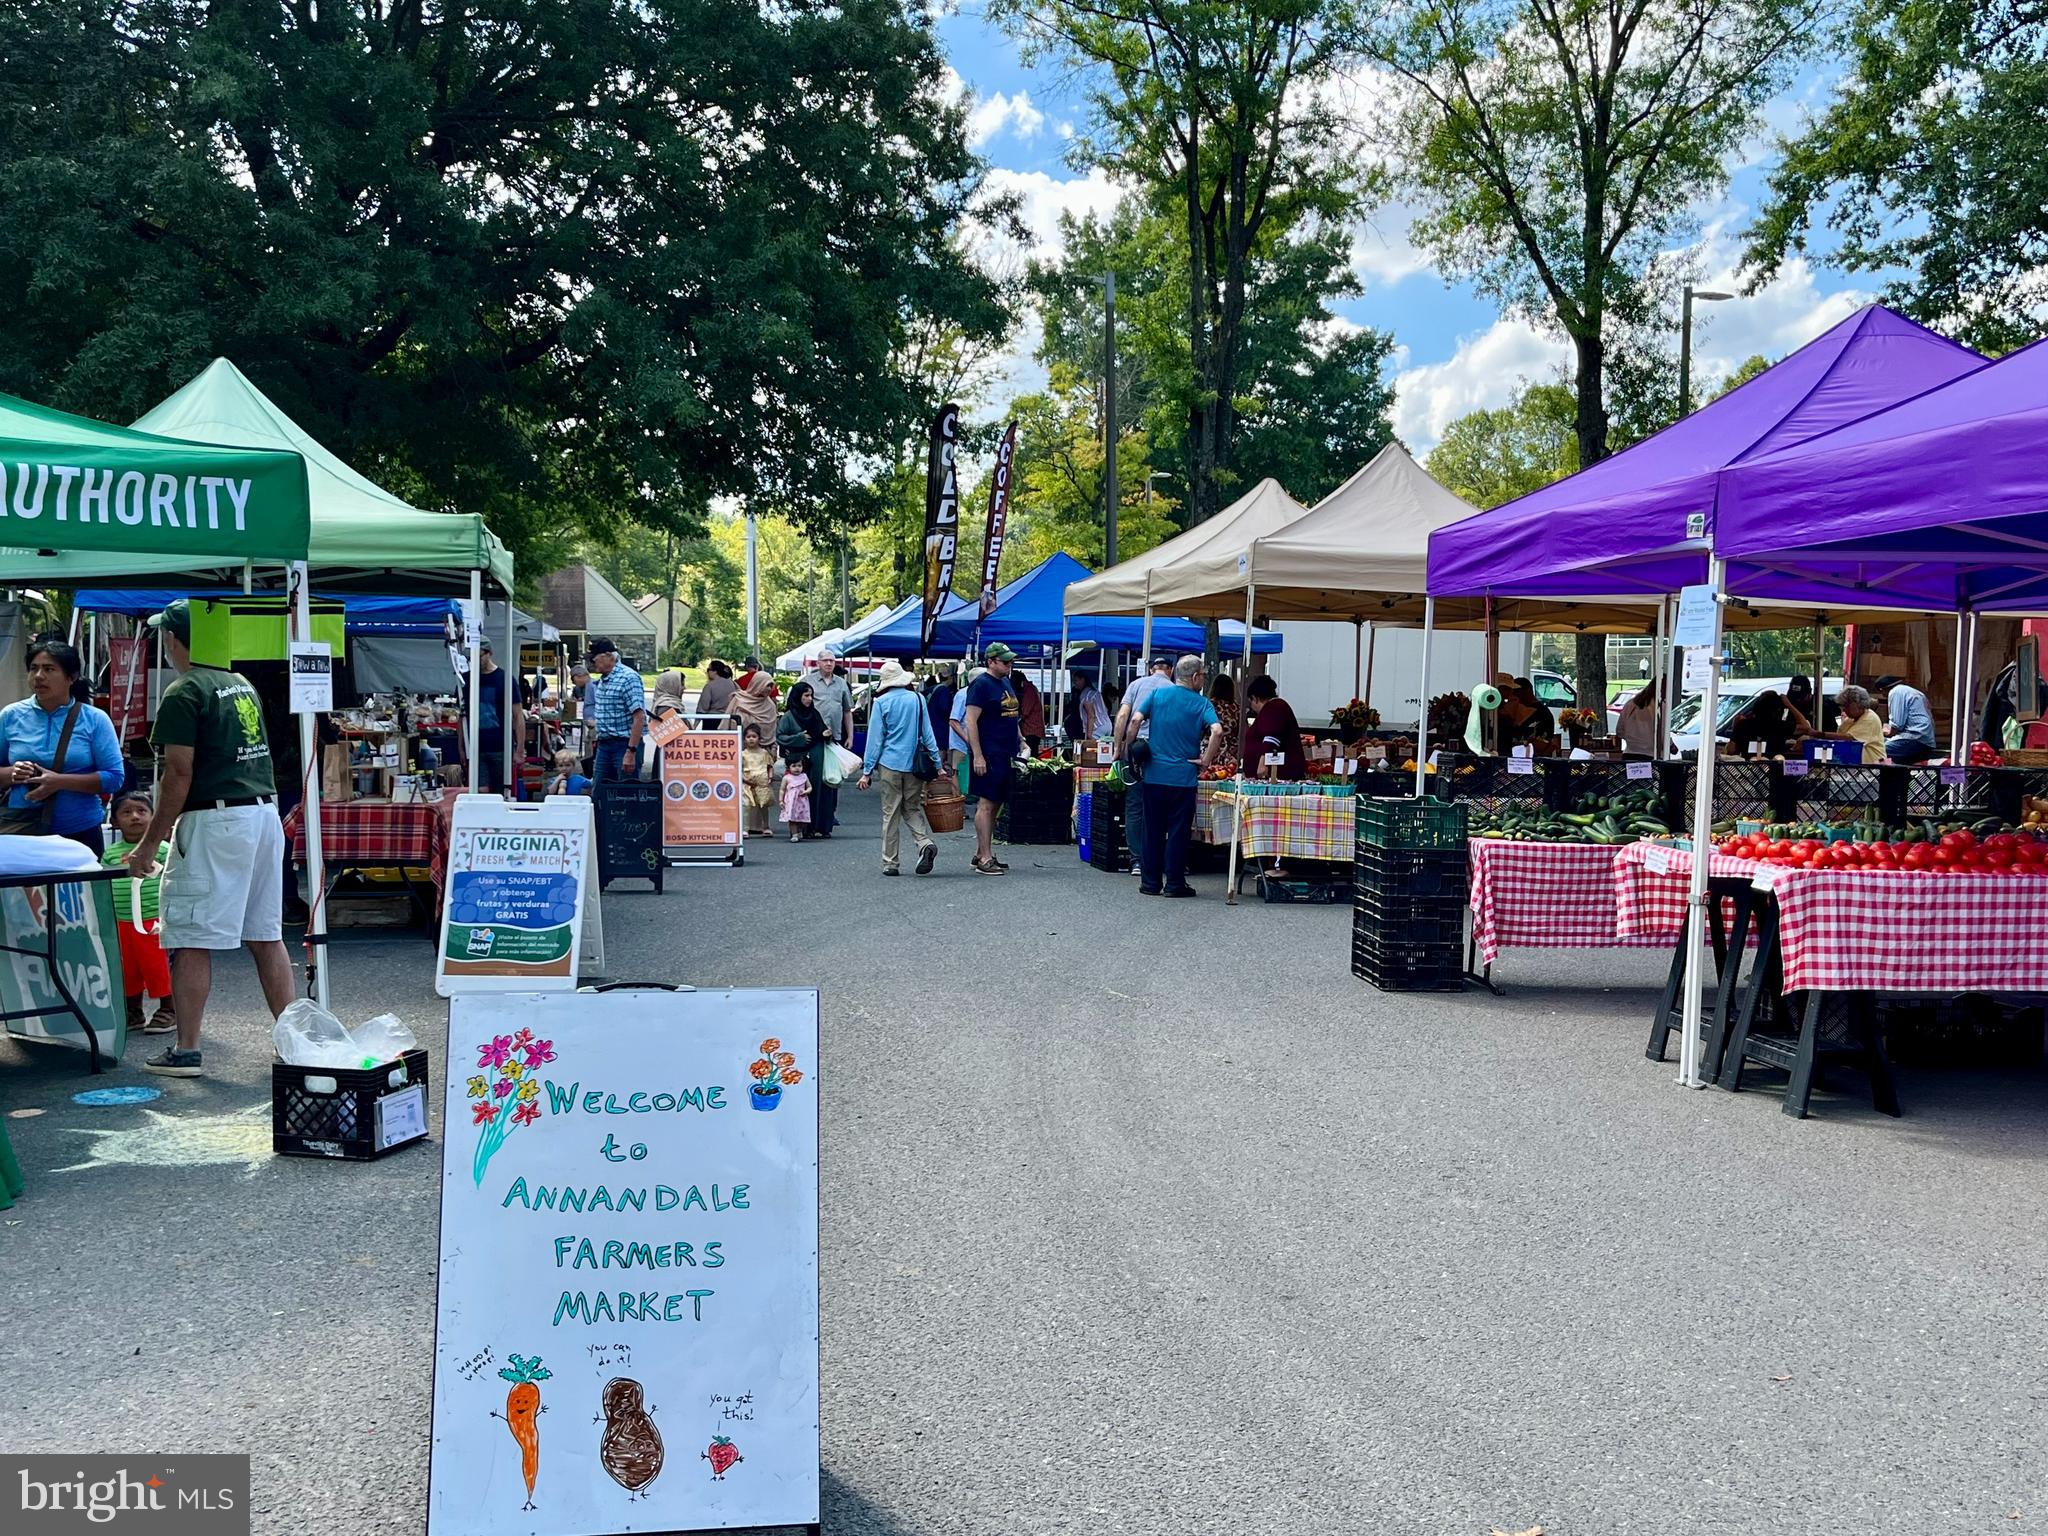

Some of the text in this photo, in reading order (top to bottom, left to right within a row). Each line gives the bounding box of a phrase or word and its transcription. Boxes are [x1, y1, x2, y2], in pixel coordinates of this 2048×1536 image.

[0, 457, 252, 531] UTHORITY
[986, 442, 1011, 580] COFFEE
[664, 738, 735, 749] MEAL PREP
[664, 751, 736, 761] MADE EASY
[477, 836, 561, 851] VIRGINIA
[475, 854, 561, 866] FRESH MATCH
[478, 876, 495, 885] Use
[508, 876, 553, 886] SNAP/EBT
[492, 888, 536, 898] y obtenga
[476, 899, 550, 909] frutas y verduras
[495, 911, 529, 919] GRATIS
[467, 942, 490, 951] SNAP
[545, 1080, 728, 1115] WELCOME
[600, 1133, 648, 1162] to
[501, 1176, 751, 1213] ANNANDALE
[554, 1236, 726, 1270] FARMERS
[553, 1289, 716, 1326] MARKET
[586, 1342, 632, 1358] you can
[709, 1389, 754, 1409] you got
[722, 1406, 755, 1420] this!
